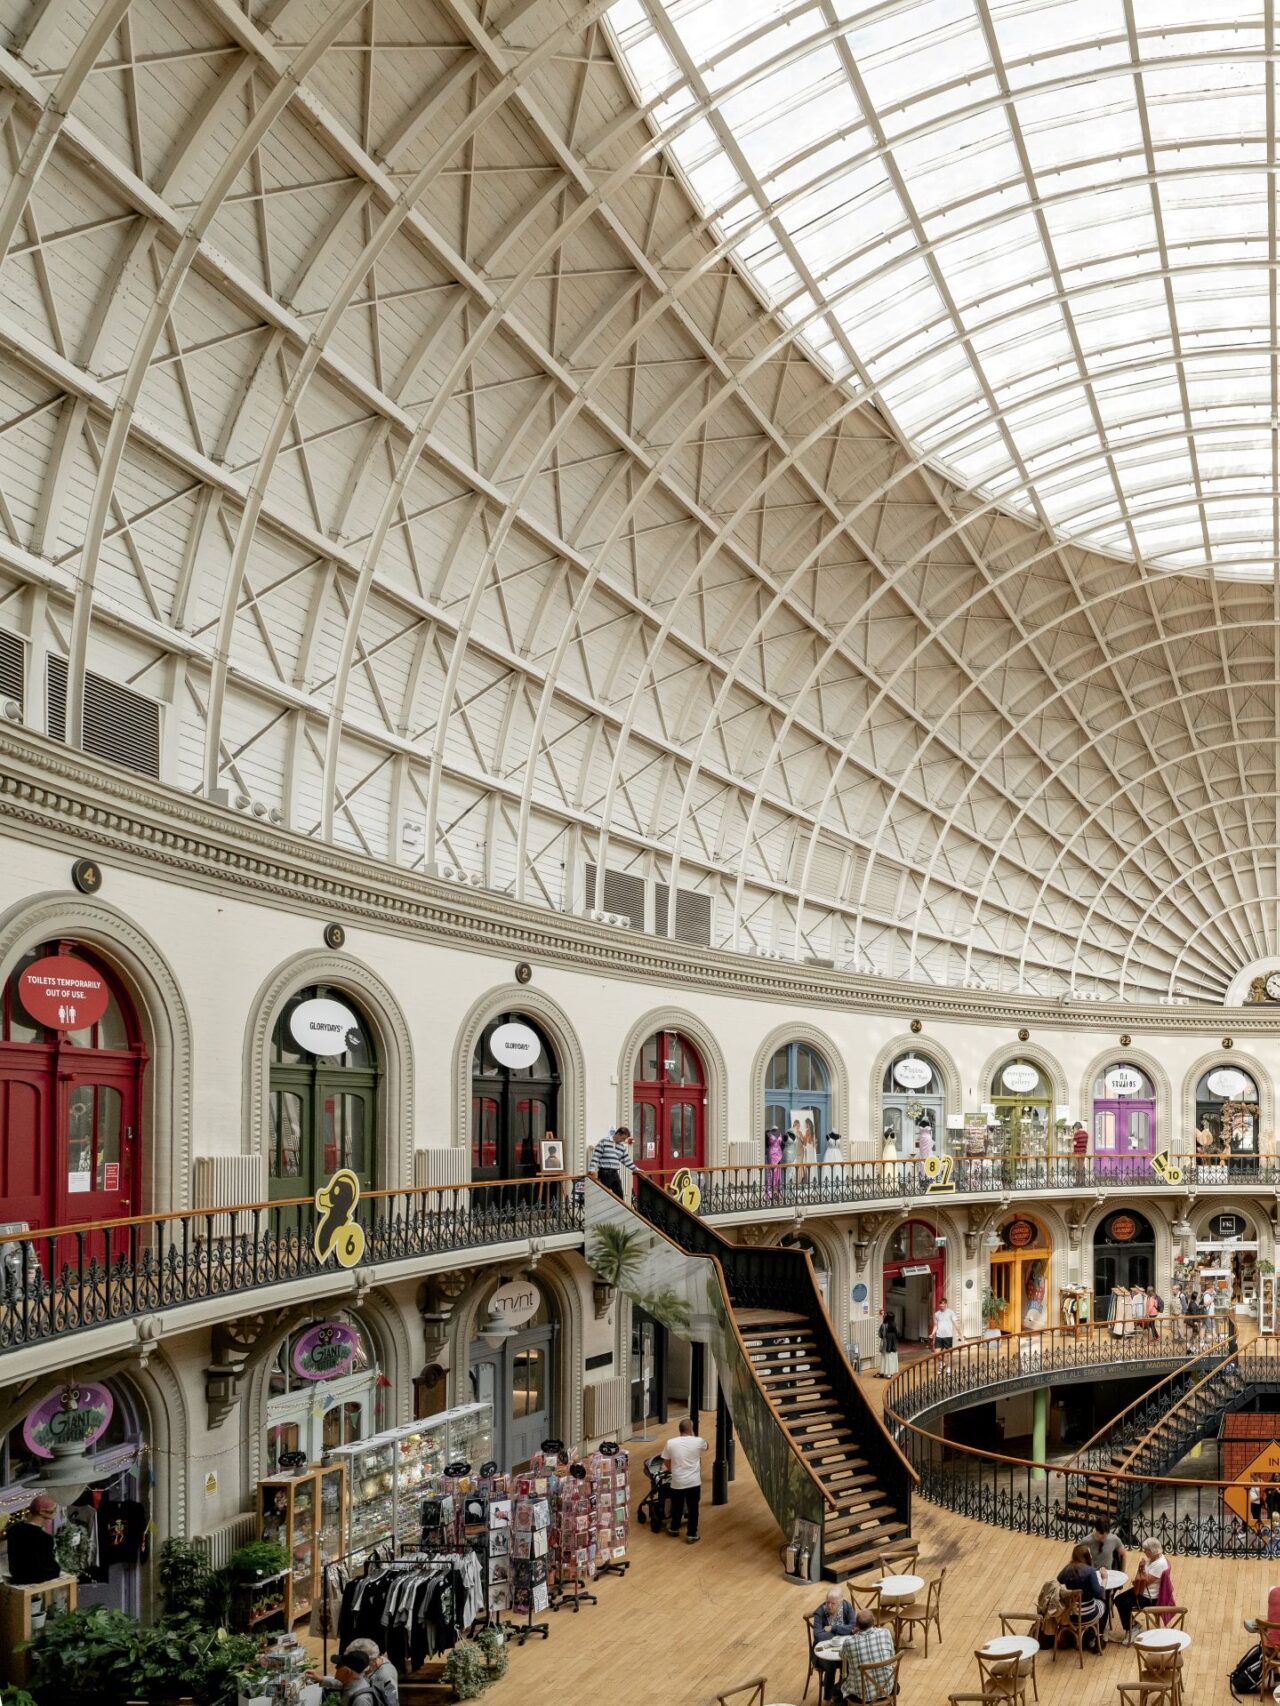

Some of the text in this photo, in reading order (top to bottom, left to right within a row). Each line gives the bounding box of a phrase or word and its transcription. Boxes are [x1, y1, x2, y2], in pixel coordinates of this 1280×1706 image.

[84, 867, 96, 884] 4
[332, 929, 341, 942] 3
[521, 968, 528, 978] 2
[27, 975, 101, 989] TOILETS TEMPORARILY
[46, 989, 86, 999] OUT OF USE.
[929, 1161, 936, 1172] 8
[1168, 1171, 1180, 1180] 10
[688, 1192, 695, 1205] 7
[346, 1234, 356, 1256] 6
[311, 1344, 341, 1363] GIANT
[1108, 1365, 1124, 1374] WITH
[1126, 1362, 1144, 1371] YOUR
[1146, 1360, 1185, 1370] IMAGINATION
[1268, 1458, 1280, 1466] IN
